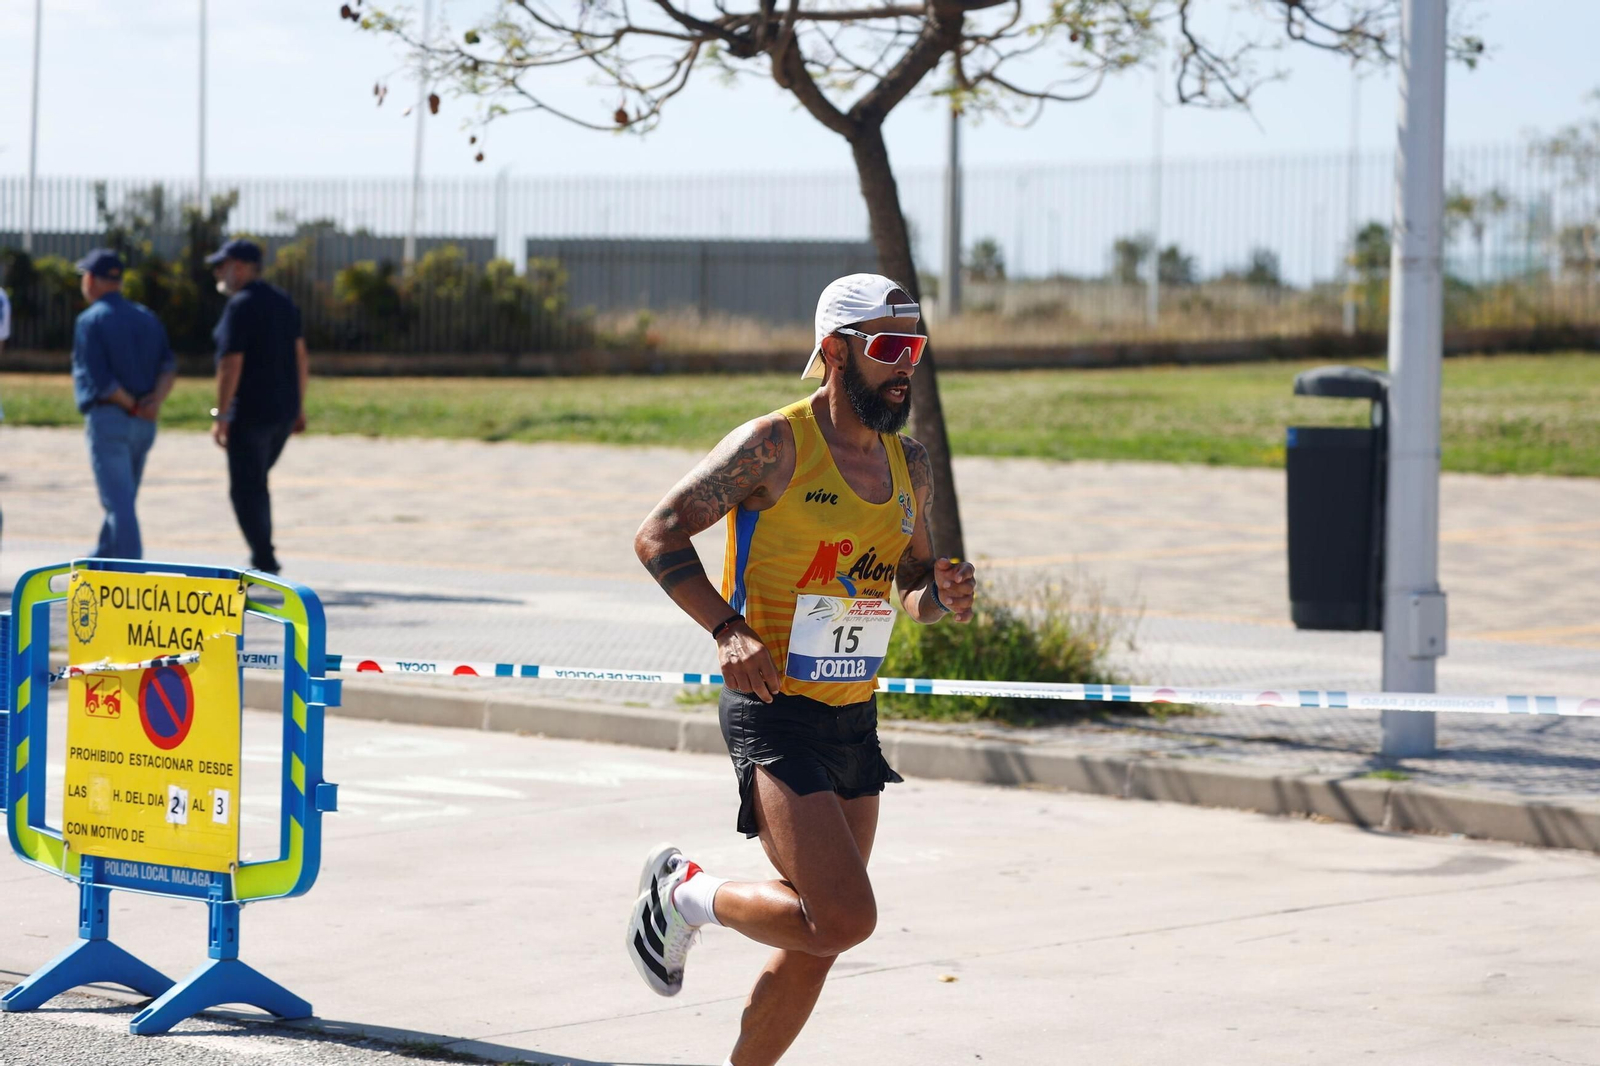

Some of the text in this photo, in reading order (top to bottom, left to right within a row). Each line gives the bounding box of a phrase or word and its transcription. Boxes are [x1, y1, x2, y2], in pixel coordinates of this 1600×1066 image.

[100, 584, 237, 617] POLICÍA LOCAL
[127, 620, 204, 652] MÁLAGA
[832, 625, 863, 653] 15
[395, 661, 437, 673] LOCAL
[70, 747, 234, 776] PROHIBIDO ESTACIONAR DESDE
[68, 784, 87, 798] LAS
[113, 789, 122, 802] H.
[125, 790, 145, 805] DEL
[147, 793, 165, 807] DIA
[192, 798, 205, 812] AL
[216, 797, 224, 815] 3
[66, 821, 145, 843] CON MOTIVO DE
[104, 860, 211, 887] POLICIA LOCAL MALAGA
